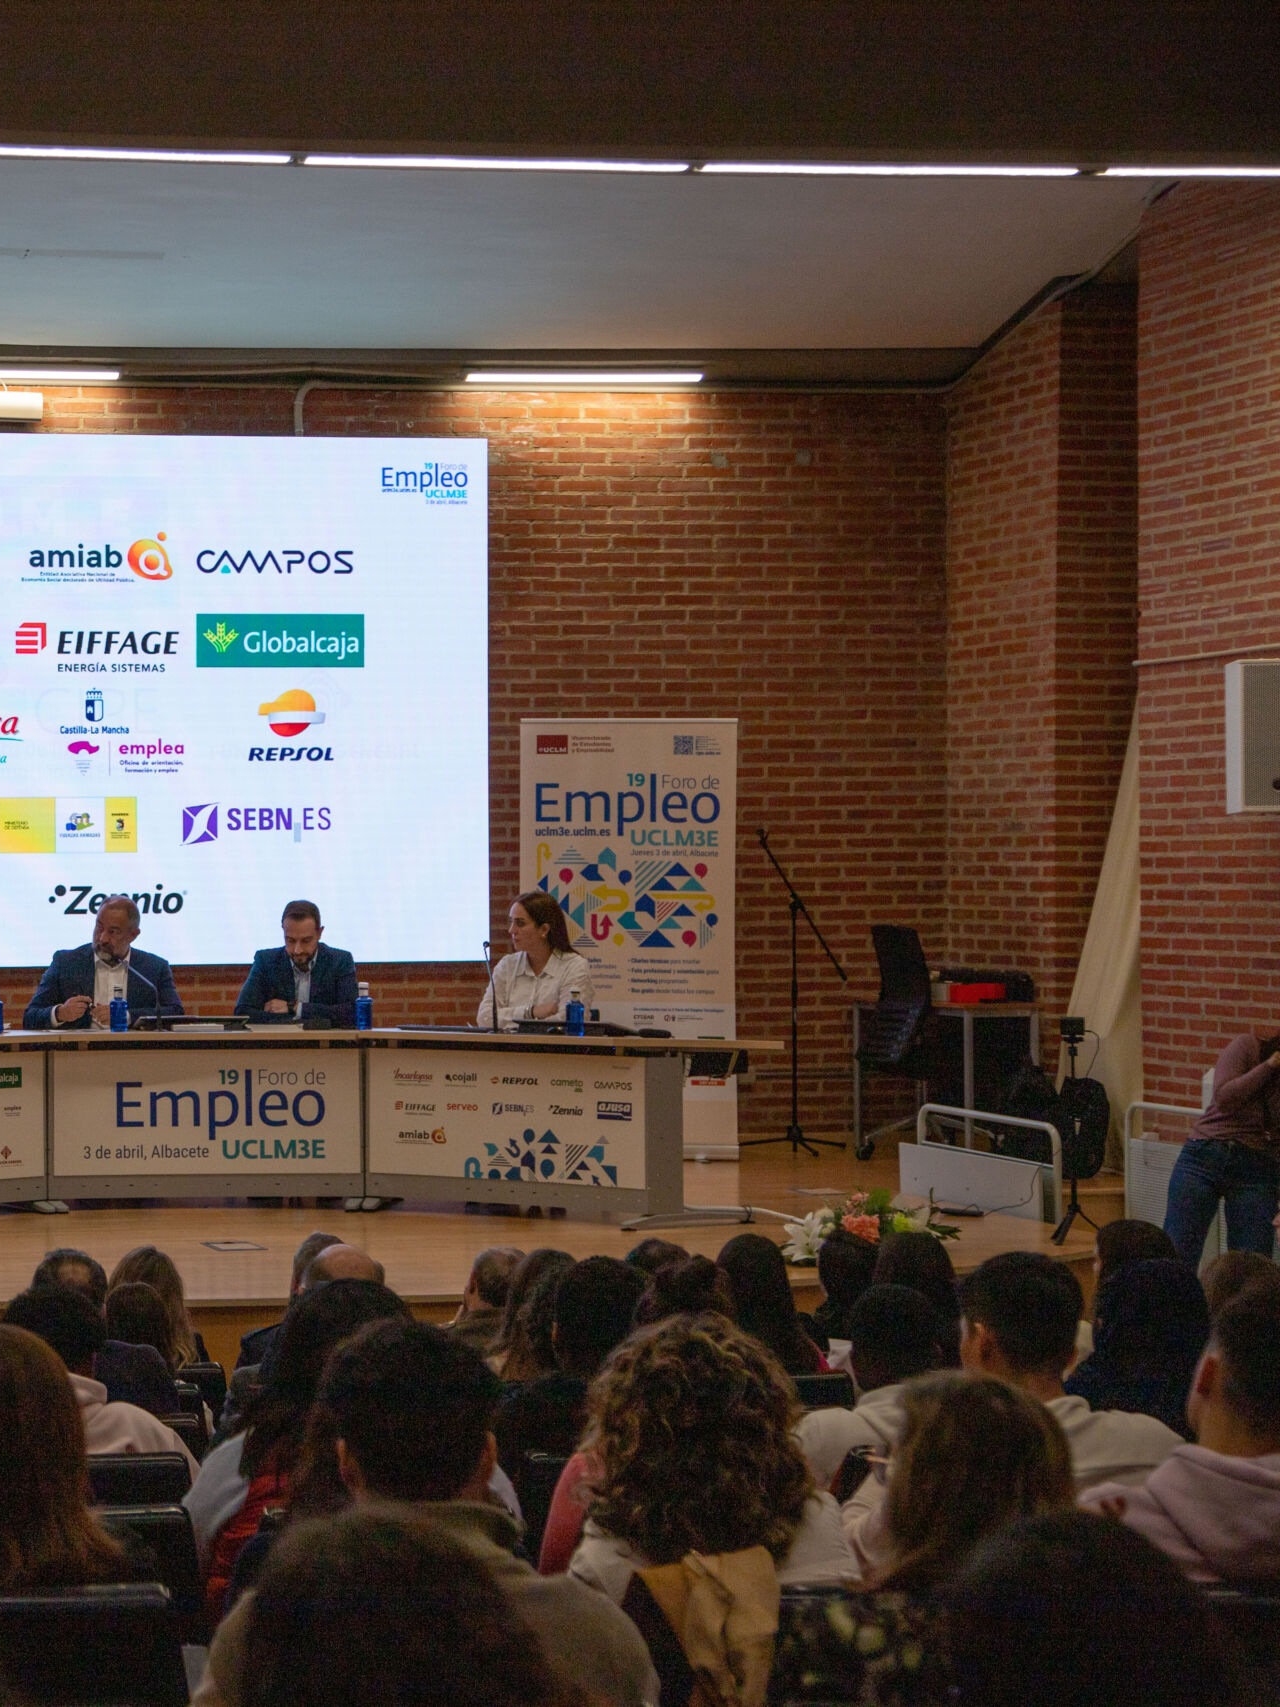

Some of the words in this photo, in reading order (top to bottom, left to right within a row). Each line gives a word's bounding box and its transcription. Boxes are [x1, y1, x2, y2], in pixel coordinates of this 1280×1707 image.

[424, 462, 433, 470] 19
[382, 463, 468, 492] Empleo
[425, 490, 468, 498] UCLM3E
[29, 544, 123, 569] amiab
[197, 550, 354, 574] CAMPOS
[57, 631, 180, 655] EIFFAGE
[243, 631, 360, 660] Globalcaja
[57, 661, 107, 673] ENERGÍA
[111, 664, 166, 673] SISTEMAS
[60, 725, 99, 734] Castilla-La
[102, 726, 130, 734] Mancha
[119, 738, 184, 758] emplea
[249, 747, 334, 761] REPSOL
[627, 773, 645, 786] 19
[662, 775, 697, 789] Foro
[701, 775, 720, 789] de
[535, 773, 720, 836] Empleo
[535, 827, 611, 836] uclm3e.uclm.es
[630, 830, 719, 847] UCLM3E
[672, 849, 689, 857] abril,
[690, 849, 719, 857] Albacete
[64, 884, 184, 914] Zenio
[219, 1070, 239, 1084] 19
[258, 1069, 298, 1085] Foro
[304, 1069, 326, 1085] de
[452, 1072, 477, 1083] cojali
[502, 1077, 539, 1086] REPSOL
[550, 1079, 583, 1087] cameto
[594, 1080, 632, 1091] CAMPOS
[116, 1069, 326, 1140] Empleo
[404, 1103, 436, 1112] EIFFAGE
[446, 1102, 478, 1111] serveo
[552, 1104, 583, 1116] Zennio
[398, 1130, 430, 1139] amiab
[84, 1147, 91, 1159] 3
[95, 1146, 111, 1159] de
[115, 1145, 147, 1161] abril,
[151, 1145, 209, 1159] Albacete
[222, 1139, 325, 1159] UCLM3E
